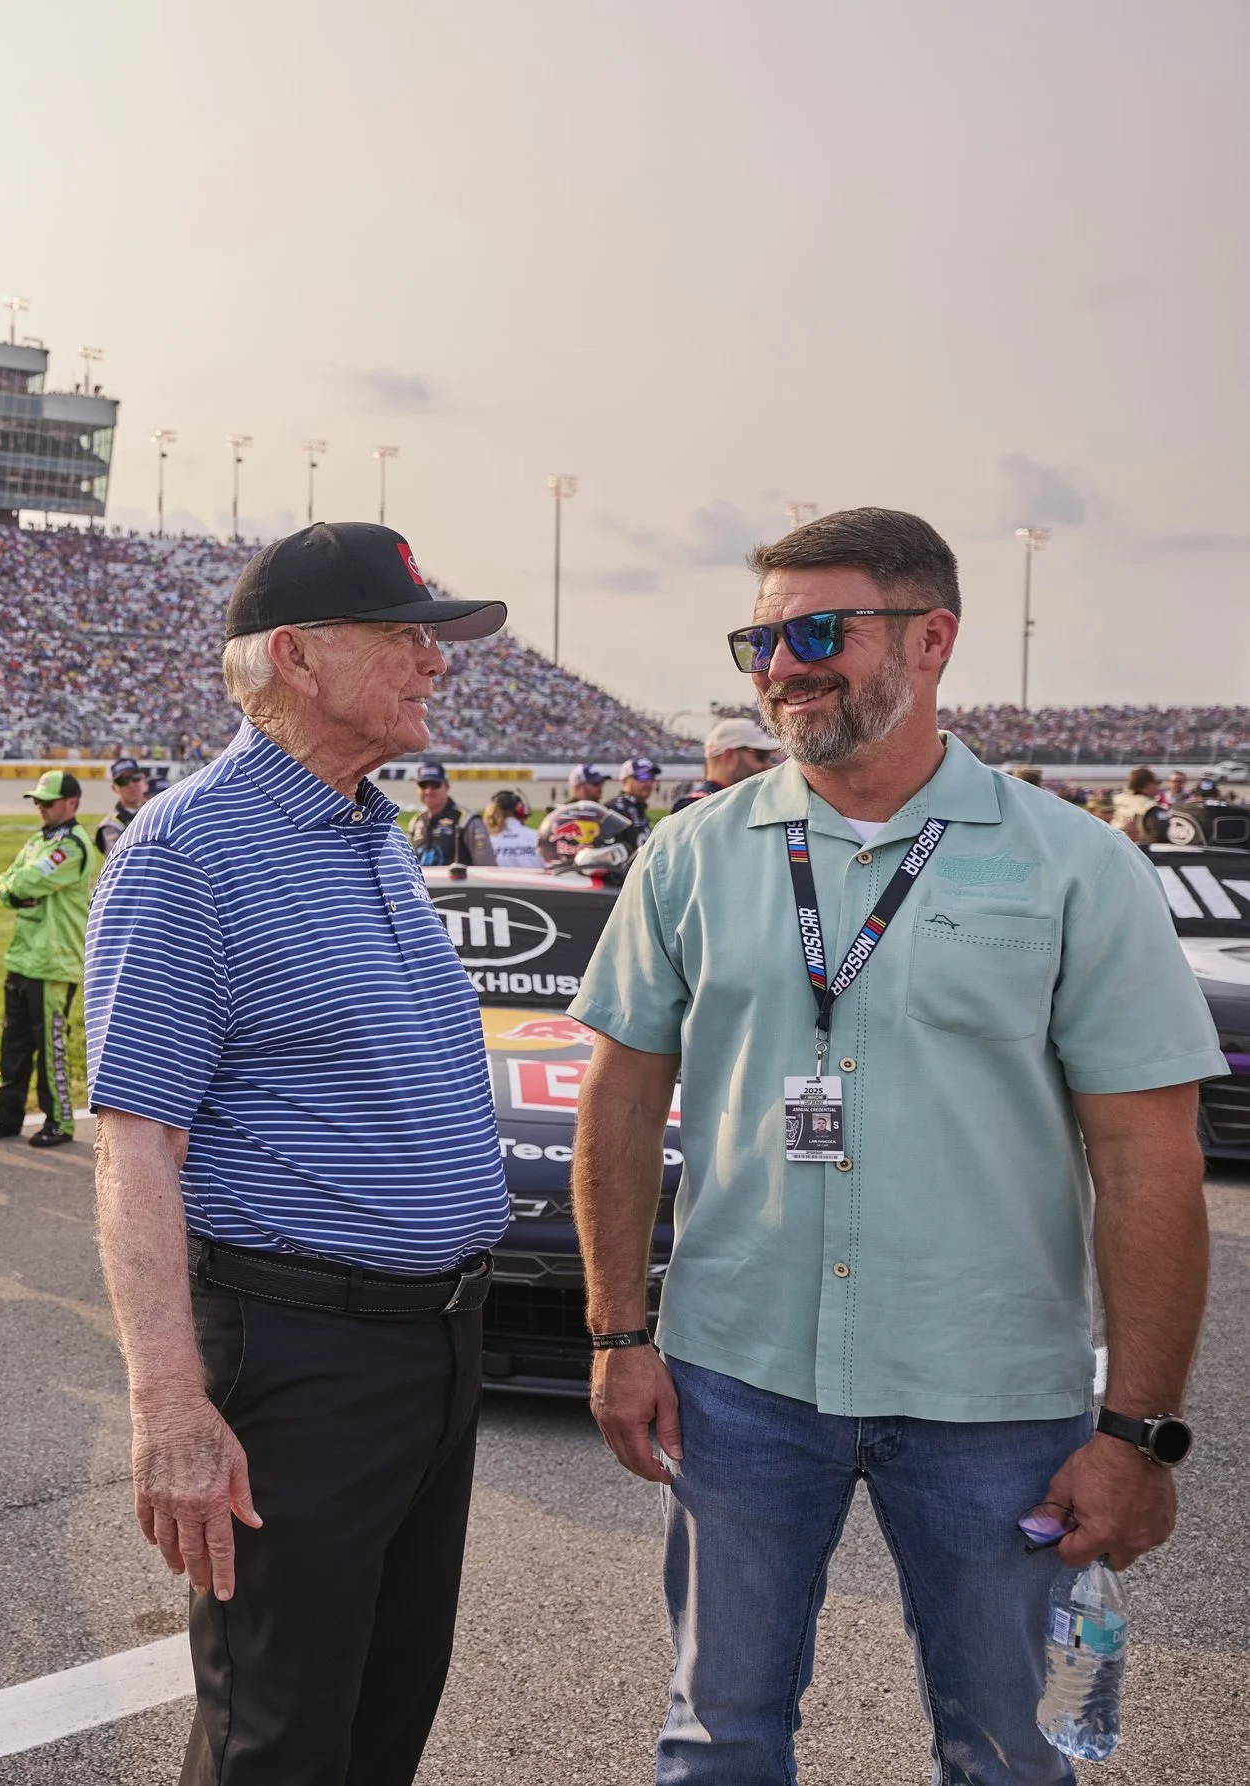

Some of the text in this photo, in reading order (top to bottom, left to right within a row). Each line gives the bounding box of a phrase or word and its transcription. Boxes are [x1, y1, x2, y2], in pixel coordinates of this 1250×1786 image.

[901, 817, 945, 876] NASCAR
[799, 906, 825, 970] NASCAR
[831, 932, 877, 997] NASCAR
[468, 971, 583, 996] KHOUS
[833, 1121, 839, 1129] S
